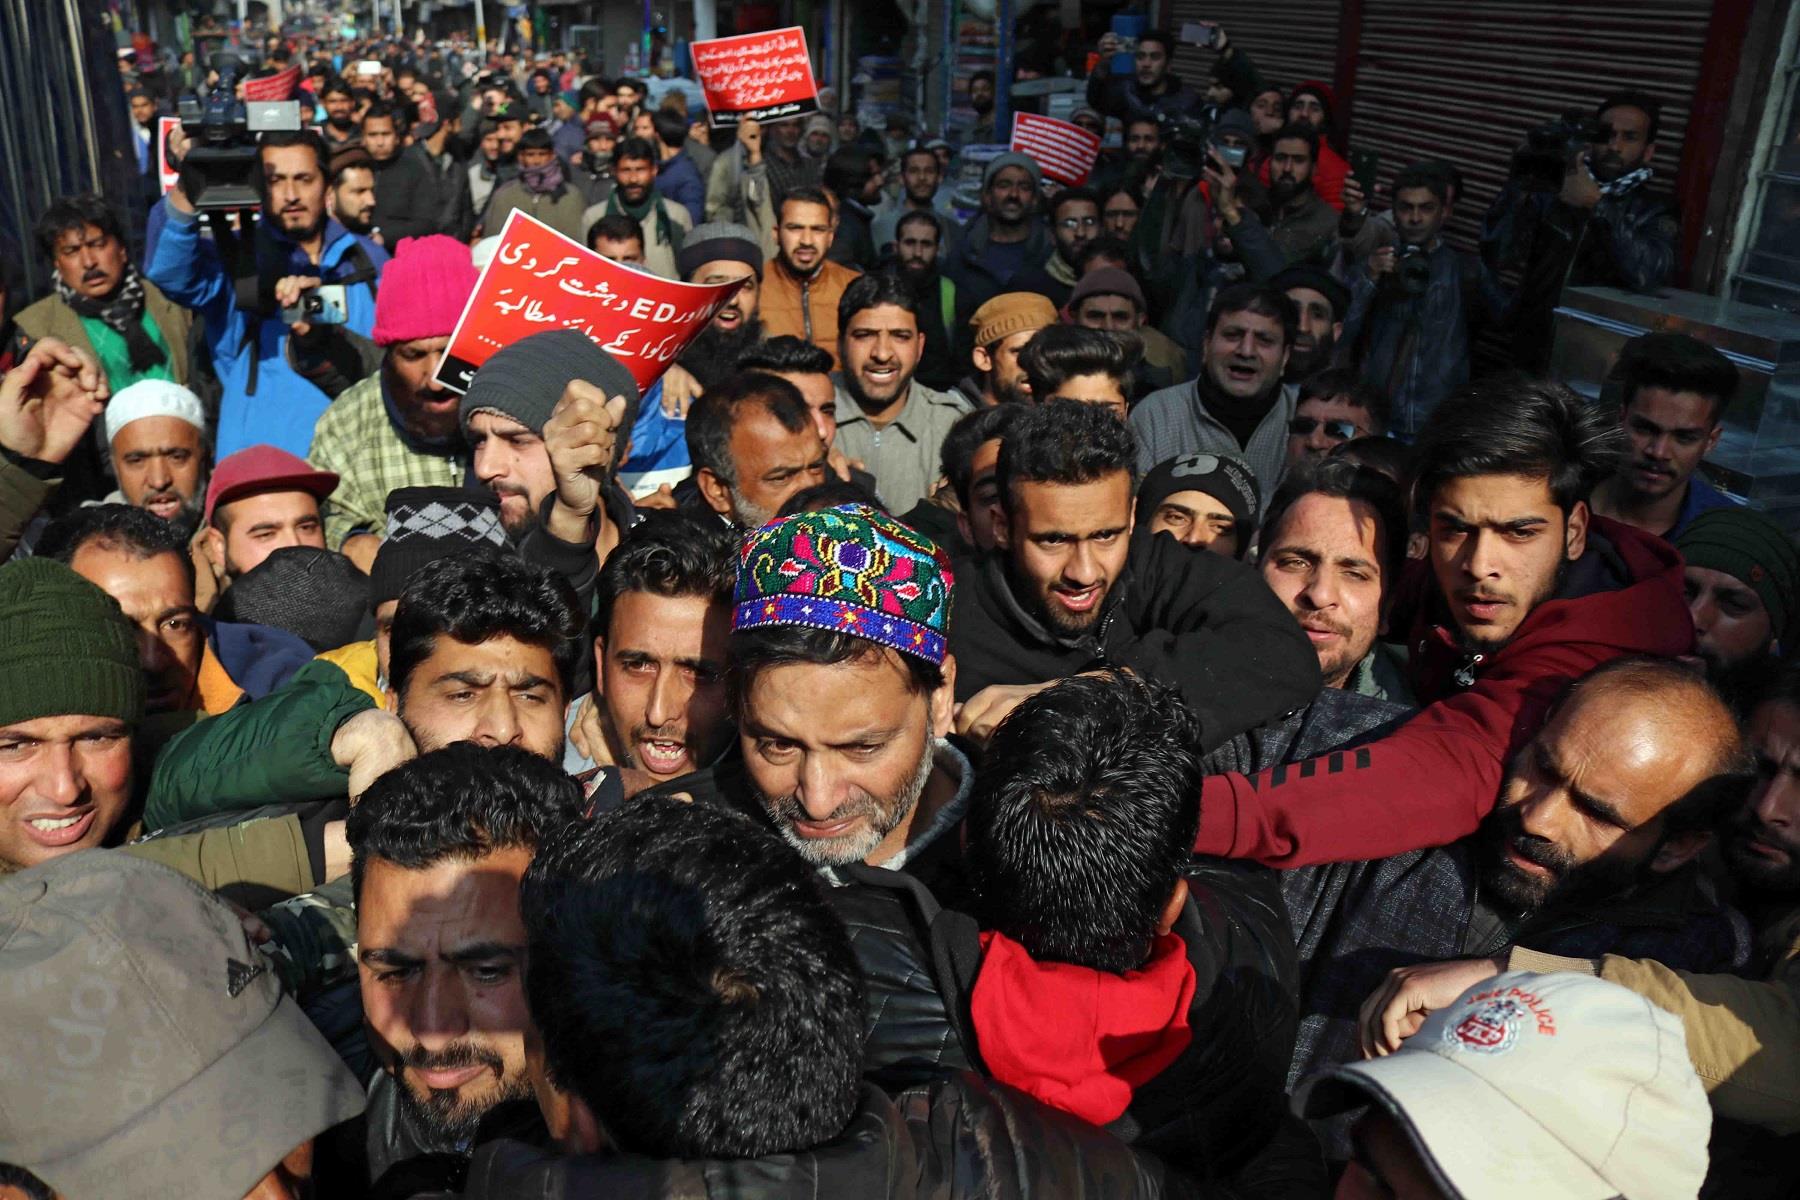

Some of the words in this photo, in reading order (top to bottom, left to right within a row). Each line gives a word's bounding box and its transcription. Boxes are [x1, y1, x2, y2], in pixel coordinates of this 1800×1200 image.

[498, 242, 580, 278] گردی
[558, 278, 629, 313] دہشت
[629, 297, 676, 323] ED
[1508, 988, 1556, 1035] POLICE
